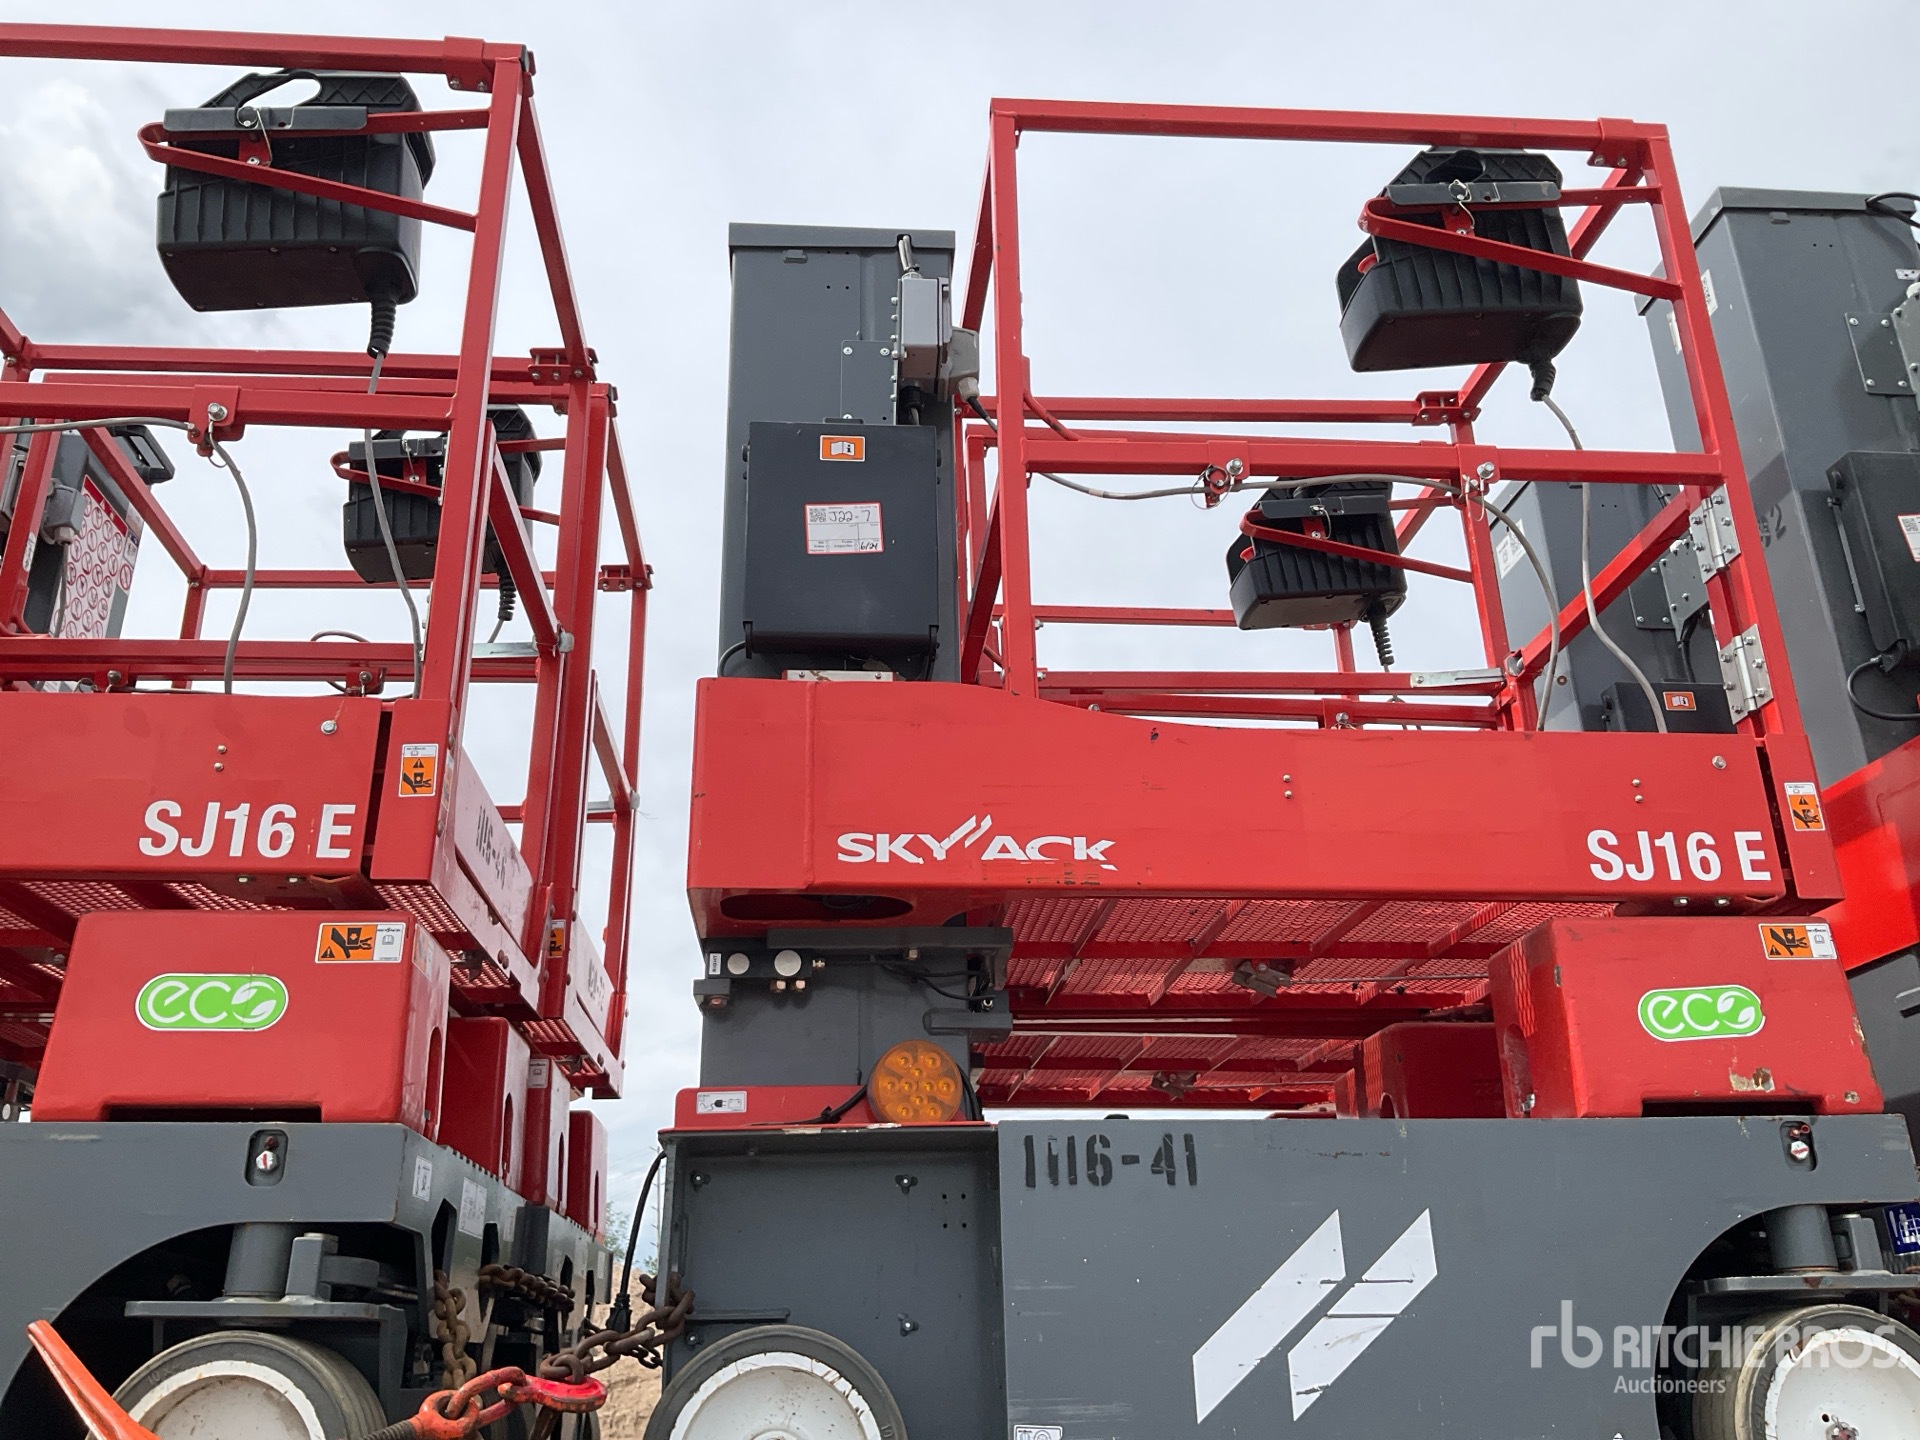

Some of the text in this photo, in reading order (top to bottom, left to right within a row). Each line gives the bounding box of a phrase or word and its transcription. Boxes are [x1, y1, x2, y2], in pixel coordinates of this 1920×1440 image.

[138, 800, 356, 859] SJ16 E
[1586, 829, 1772, 882] SJ16 E
[147, 980, 277, 1024] eco
[1647, 990, 1756, 1035] eco
[1024, 1133, 1198, 1188] 1116-41
